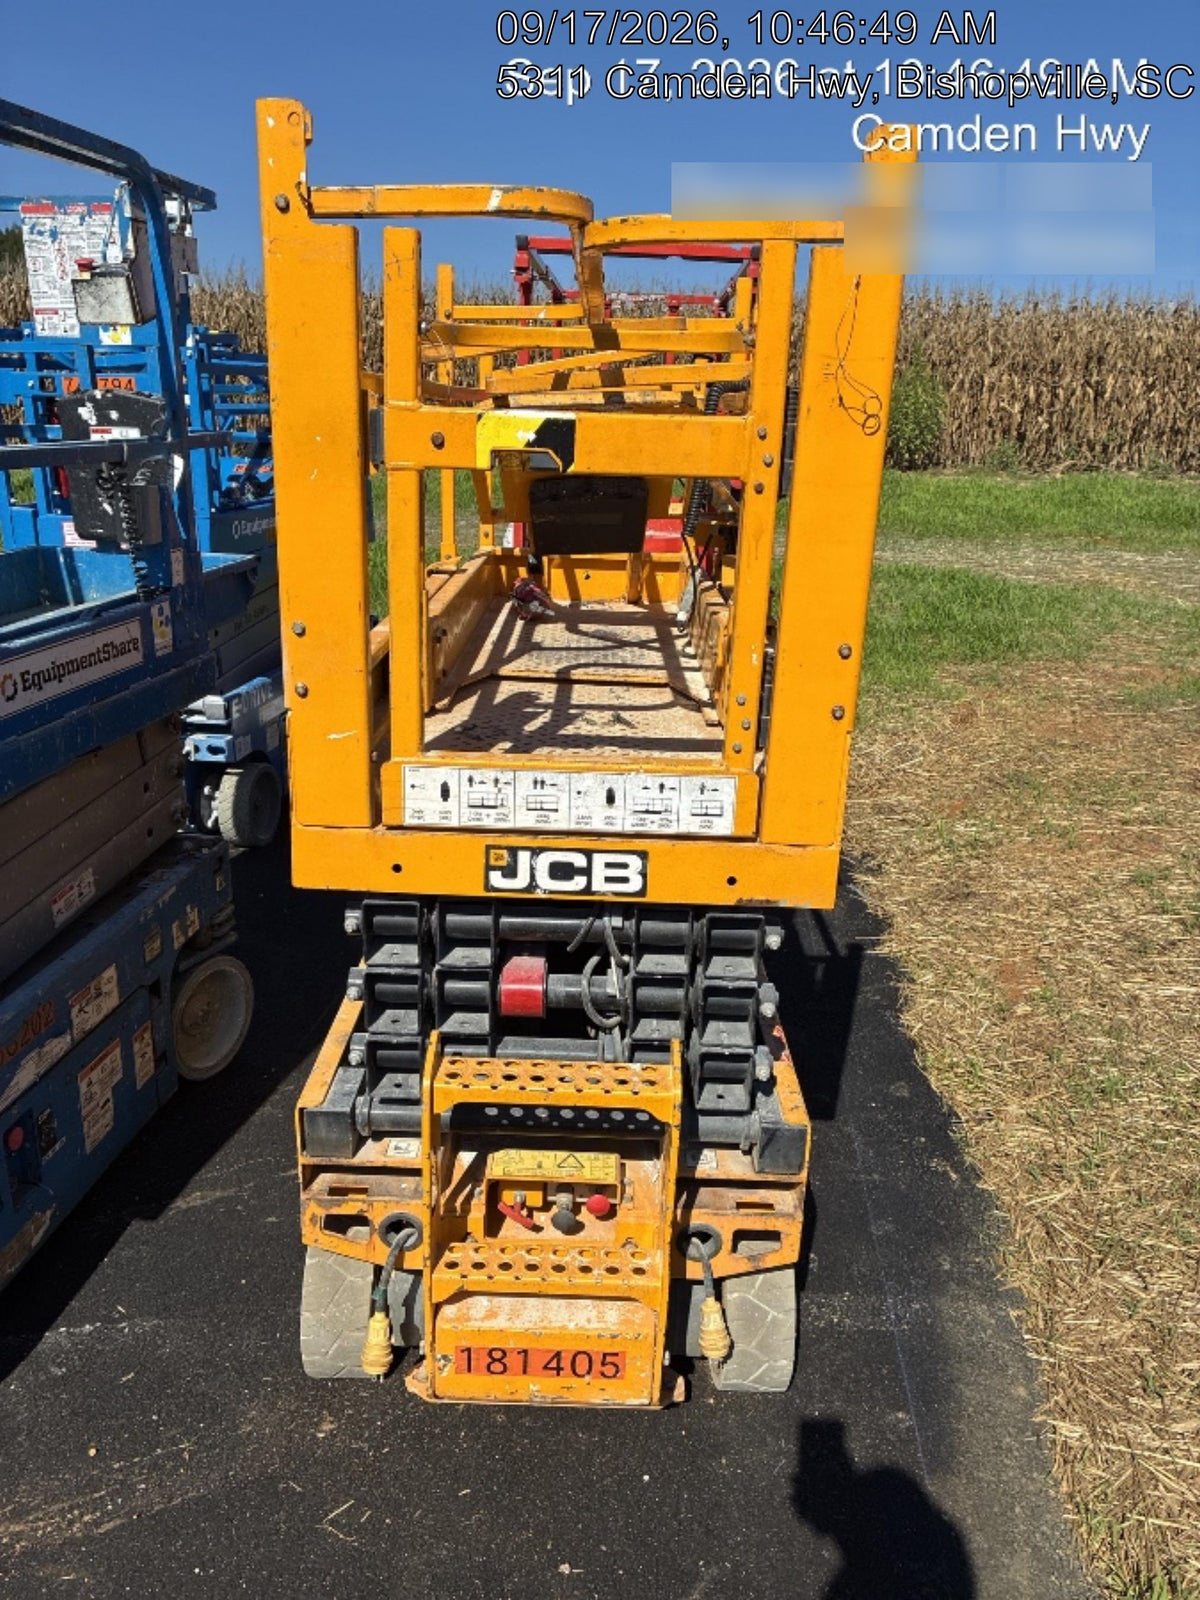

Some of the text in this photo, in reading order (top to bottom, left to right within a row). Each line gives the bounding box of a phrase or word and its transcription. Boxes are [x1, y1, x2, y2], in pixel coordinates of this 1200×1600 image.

[20, 637, 140, 692] EquipmentShare
[488, 850, 642, 893] JCB
[459, 1346, 621, 1379] 181405
